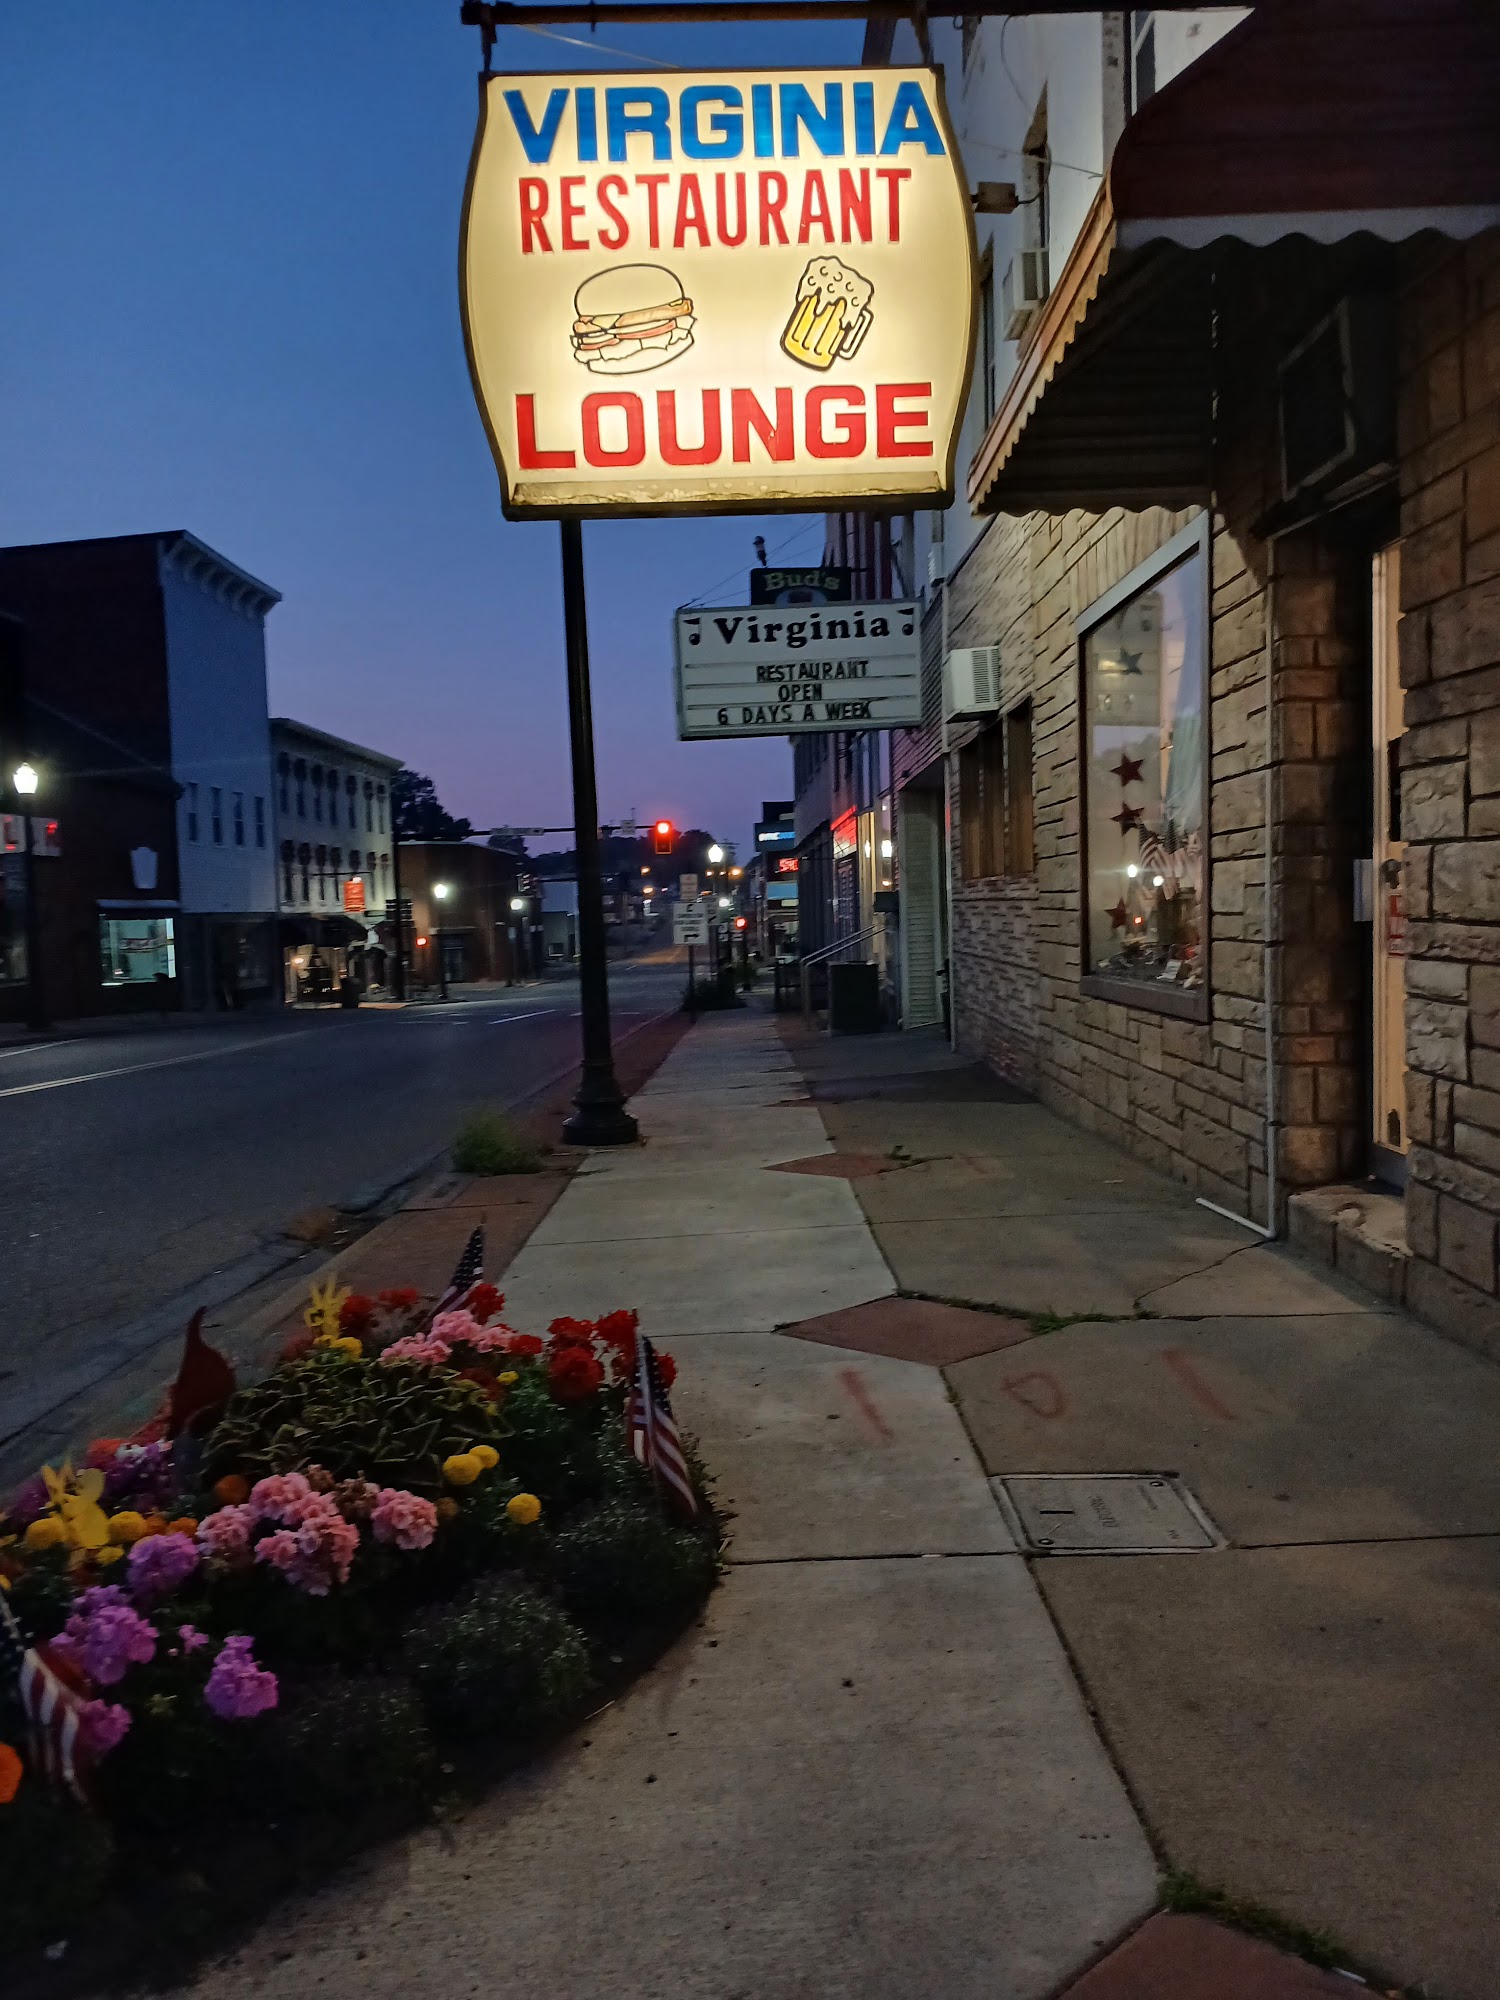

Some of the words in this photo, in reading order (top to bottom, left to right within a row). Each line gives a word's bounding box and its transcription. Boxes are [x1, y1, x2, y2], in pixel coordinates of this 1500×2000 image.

[502, 81, 947, 164] VIRGINIA
[518, 167, 912, 254] RESTAURANT
[515, 382, 934, 470] LOUNGE
[764, 570, 841, 592] Bud's
[713, 610, 890, 649] Virginia
[756, 660, 869, 683] RESTAURANT
[778, 683, 823, 702] OPEN
[717, 708, 729, 725] 6
[742, 704, 793, 724] DAYS
[803, 703, 816, 722] A
[825, 701, 873, 720] WEEK
